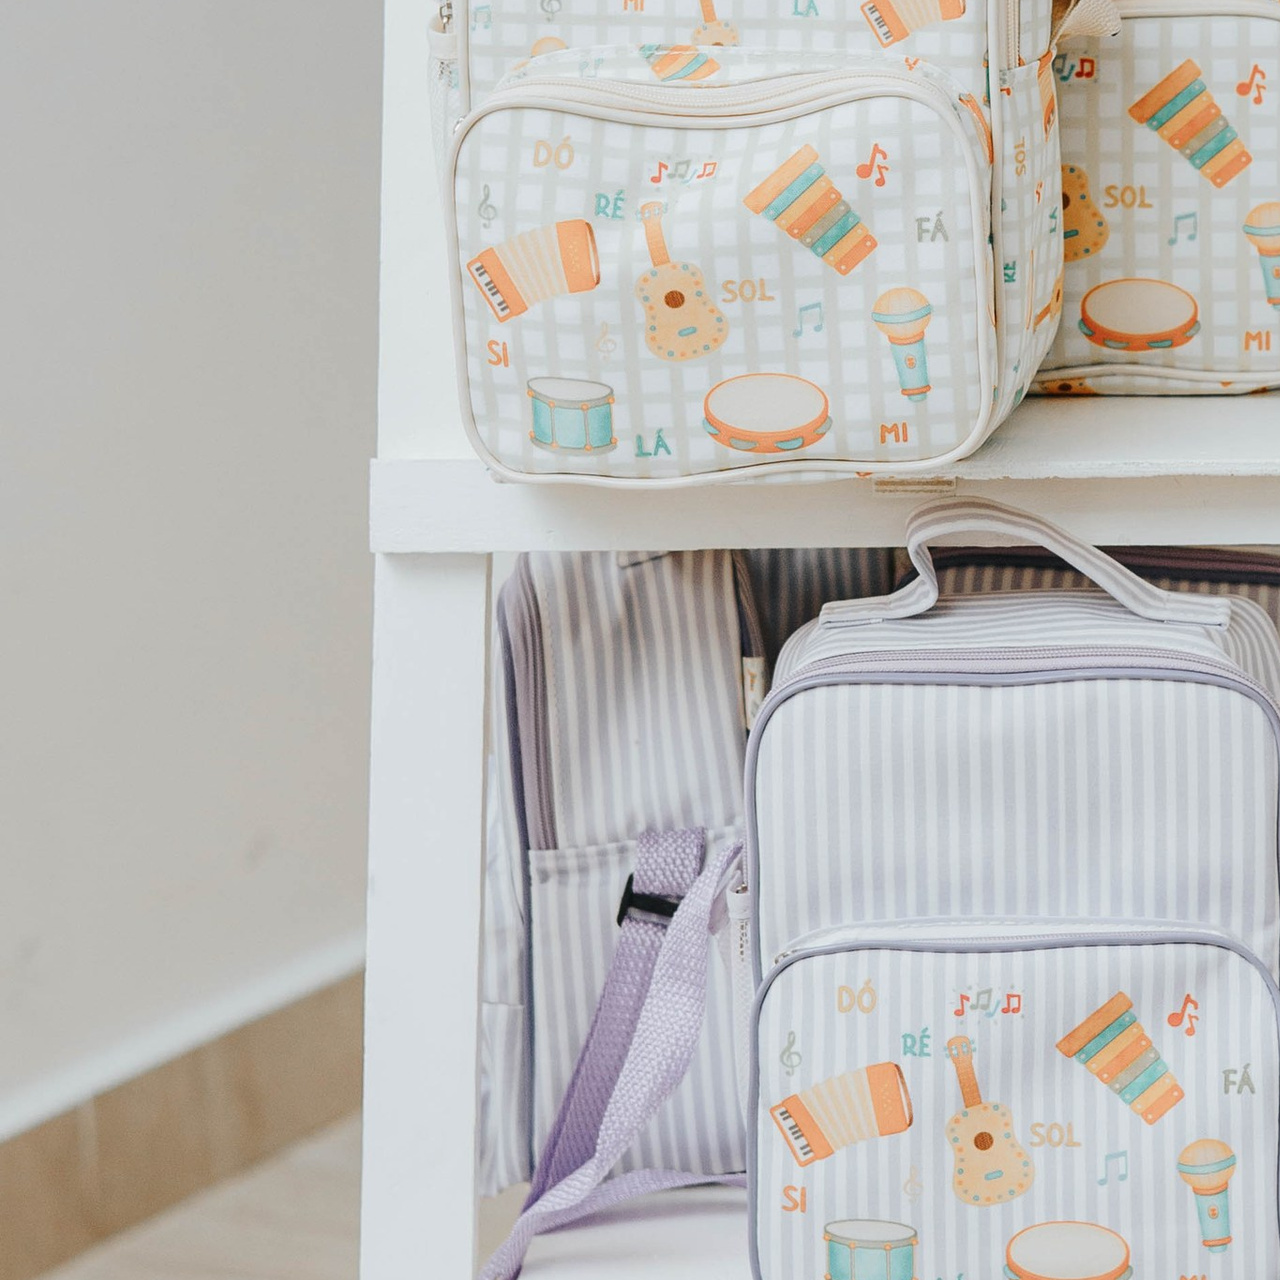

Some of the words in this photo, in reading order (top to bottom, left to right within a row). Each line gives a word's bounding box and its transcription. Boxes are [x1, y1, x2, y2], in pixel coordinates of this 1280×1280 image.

[533, 136, 575, 170] DÓ
[595, 190, 626, 219] RÉ
[1103, 184, 1153, 209] SOL
[917, 211, 948, 243] FÁ
[721, 279, 775, 303] SOL
[487, 340, 509, 367] SI
[1244, 331, 1271, 351] MI
[635, 428, 672, 457] LÁ
[880, 422, 908, 443] MI
[836, 978, 876, 1014] DÓ
[902, 1028, 933, 1057] RÉ
[1223, 1062, 1255, 1095] FÁ
[1029, 1122, 1081, 1148] SOL
[782, 1186, 807, 1213] SI
